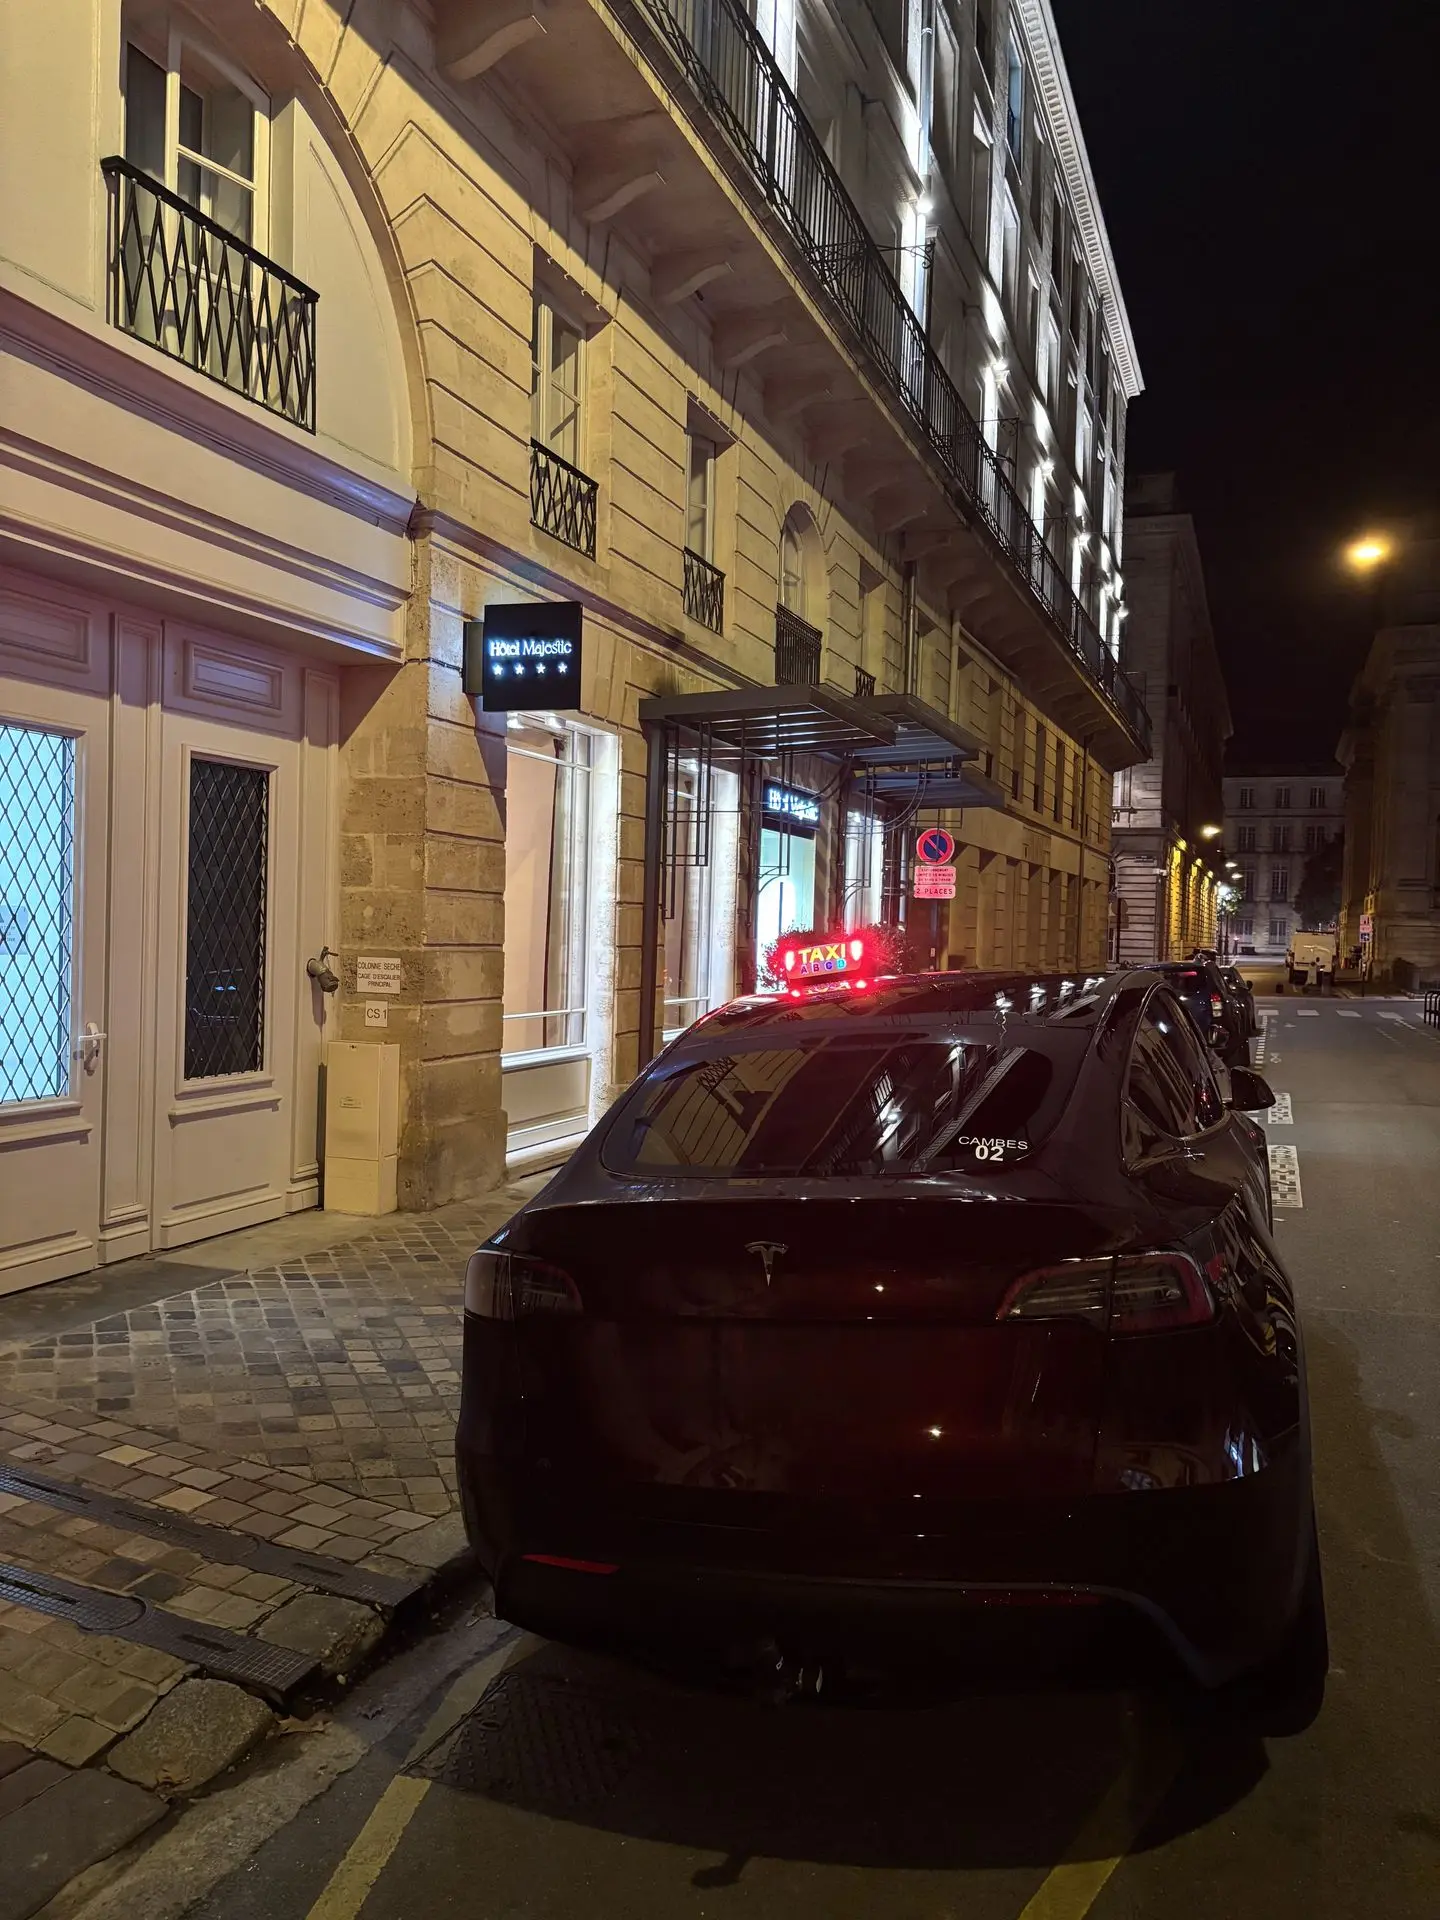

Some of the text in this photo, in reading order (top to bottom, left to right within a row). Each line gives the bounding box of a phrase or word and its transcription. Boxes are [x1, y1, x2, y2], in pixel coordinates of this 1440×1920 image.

[489, 639, 572, 657] Hôtel Majestic
[798, 943, 846, 965] TAXI
[358, 961, 401, 971] COLONNE SECHE
[358, 972, 400, 981] CAGE D'ESCALIER
[368, 980, 392, 988] PRINCIPAL
[958, 1136, 1028, 1150] CAMBES
[975, 1145, 1004, 1161] 02
